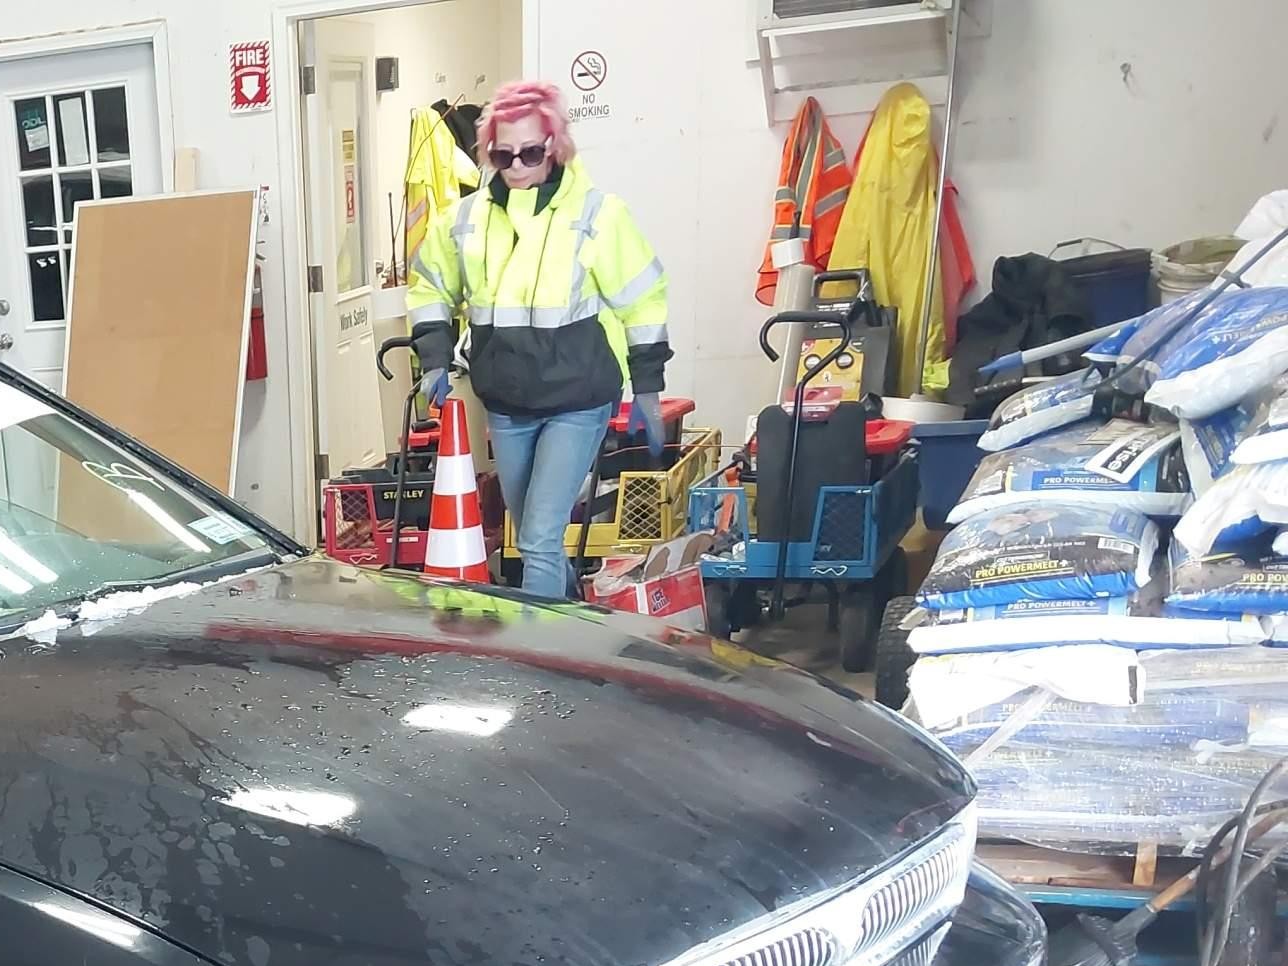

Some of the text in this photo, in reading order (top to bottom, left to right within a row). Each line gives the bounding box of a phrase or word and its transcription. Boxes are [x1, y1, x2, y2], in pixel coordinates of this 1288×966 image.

[235, 49, 265, 67] FIRE
[581, 93, 596, 105] NO
[568, 105, 610, 119] SMOKING
[1043, 475, 1062, 485] PRO
[383, 489, 424, 500] STALEY
[975, 567, 997, 579] PRO
[1242, 572, 1265, 582] PRO
[1007, 601, 1026, 610] PRO
